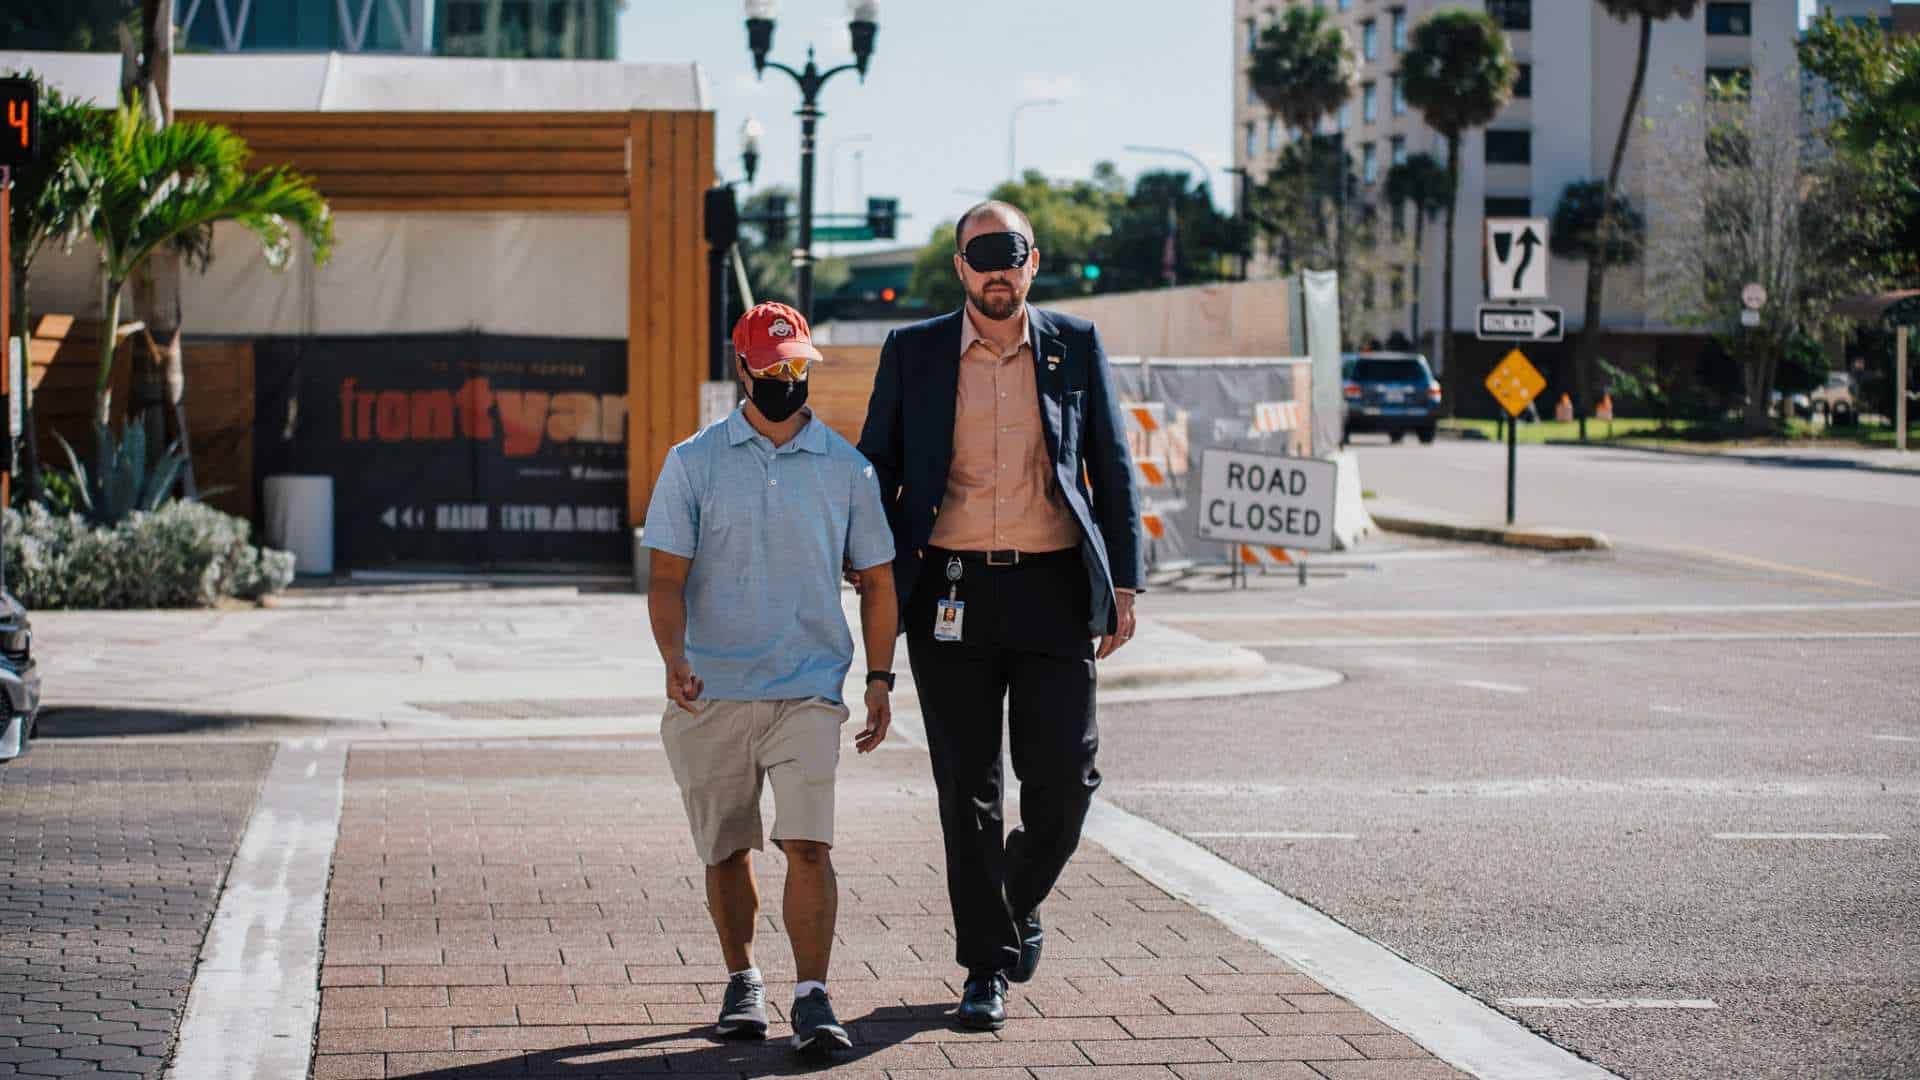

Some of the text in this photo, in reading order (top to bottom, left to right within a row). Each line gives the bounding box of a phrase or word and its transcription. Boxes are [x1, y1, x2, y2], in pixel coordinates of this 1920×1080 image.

[8, 98, 29, 148] 4
[1227, 462, 1307, 497] ROAD
[1208, 499, 1321, 537] CLOSED
